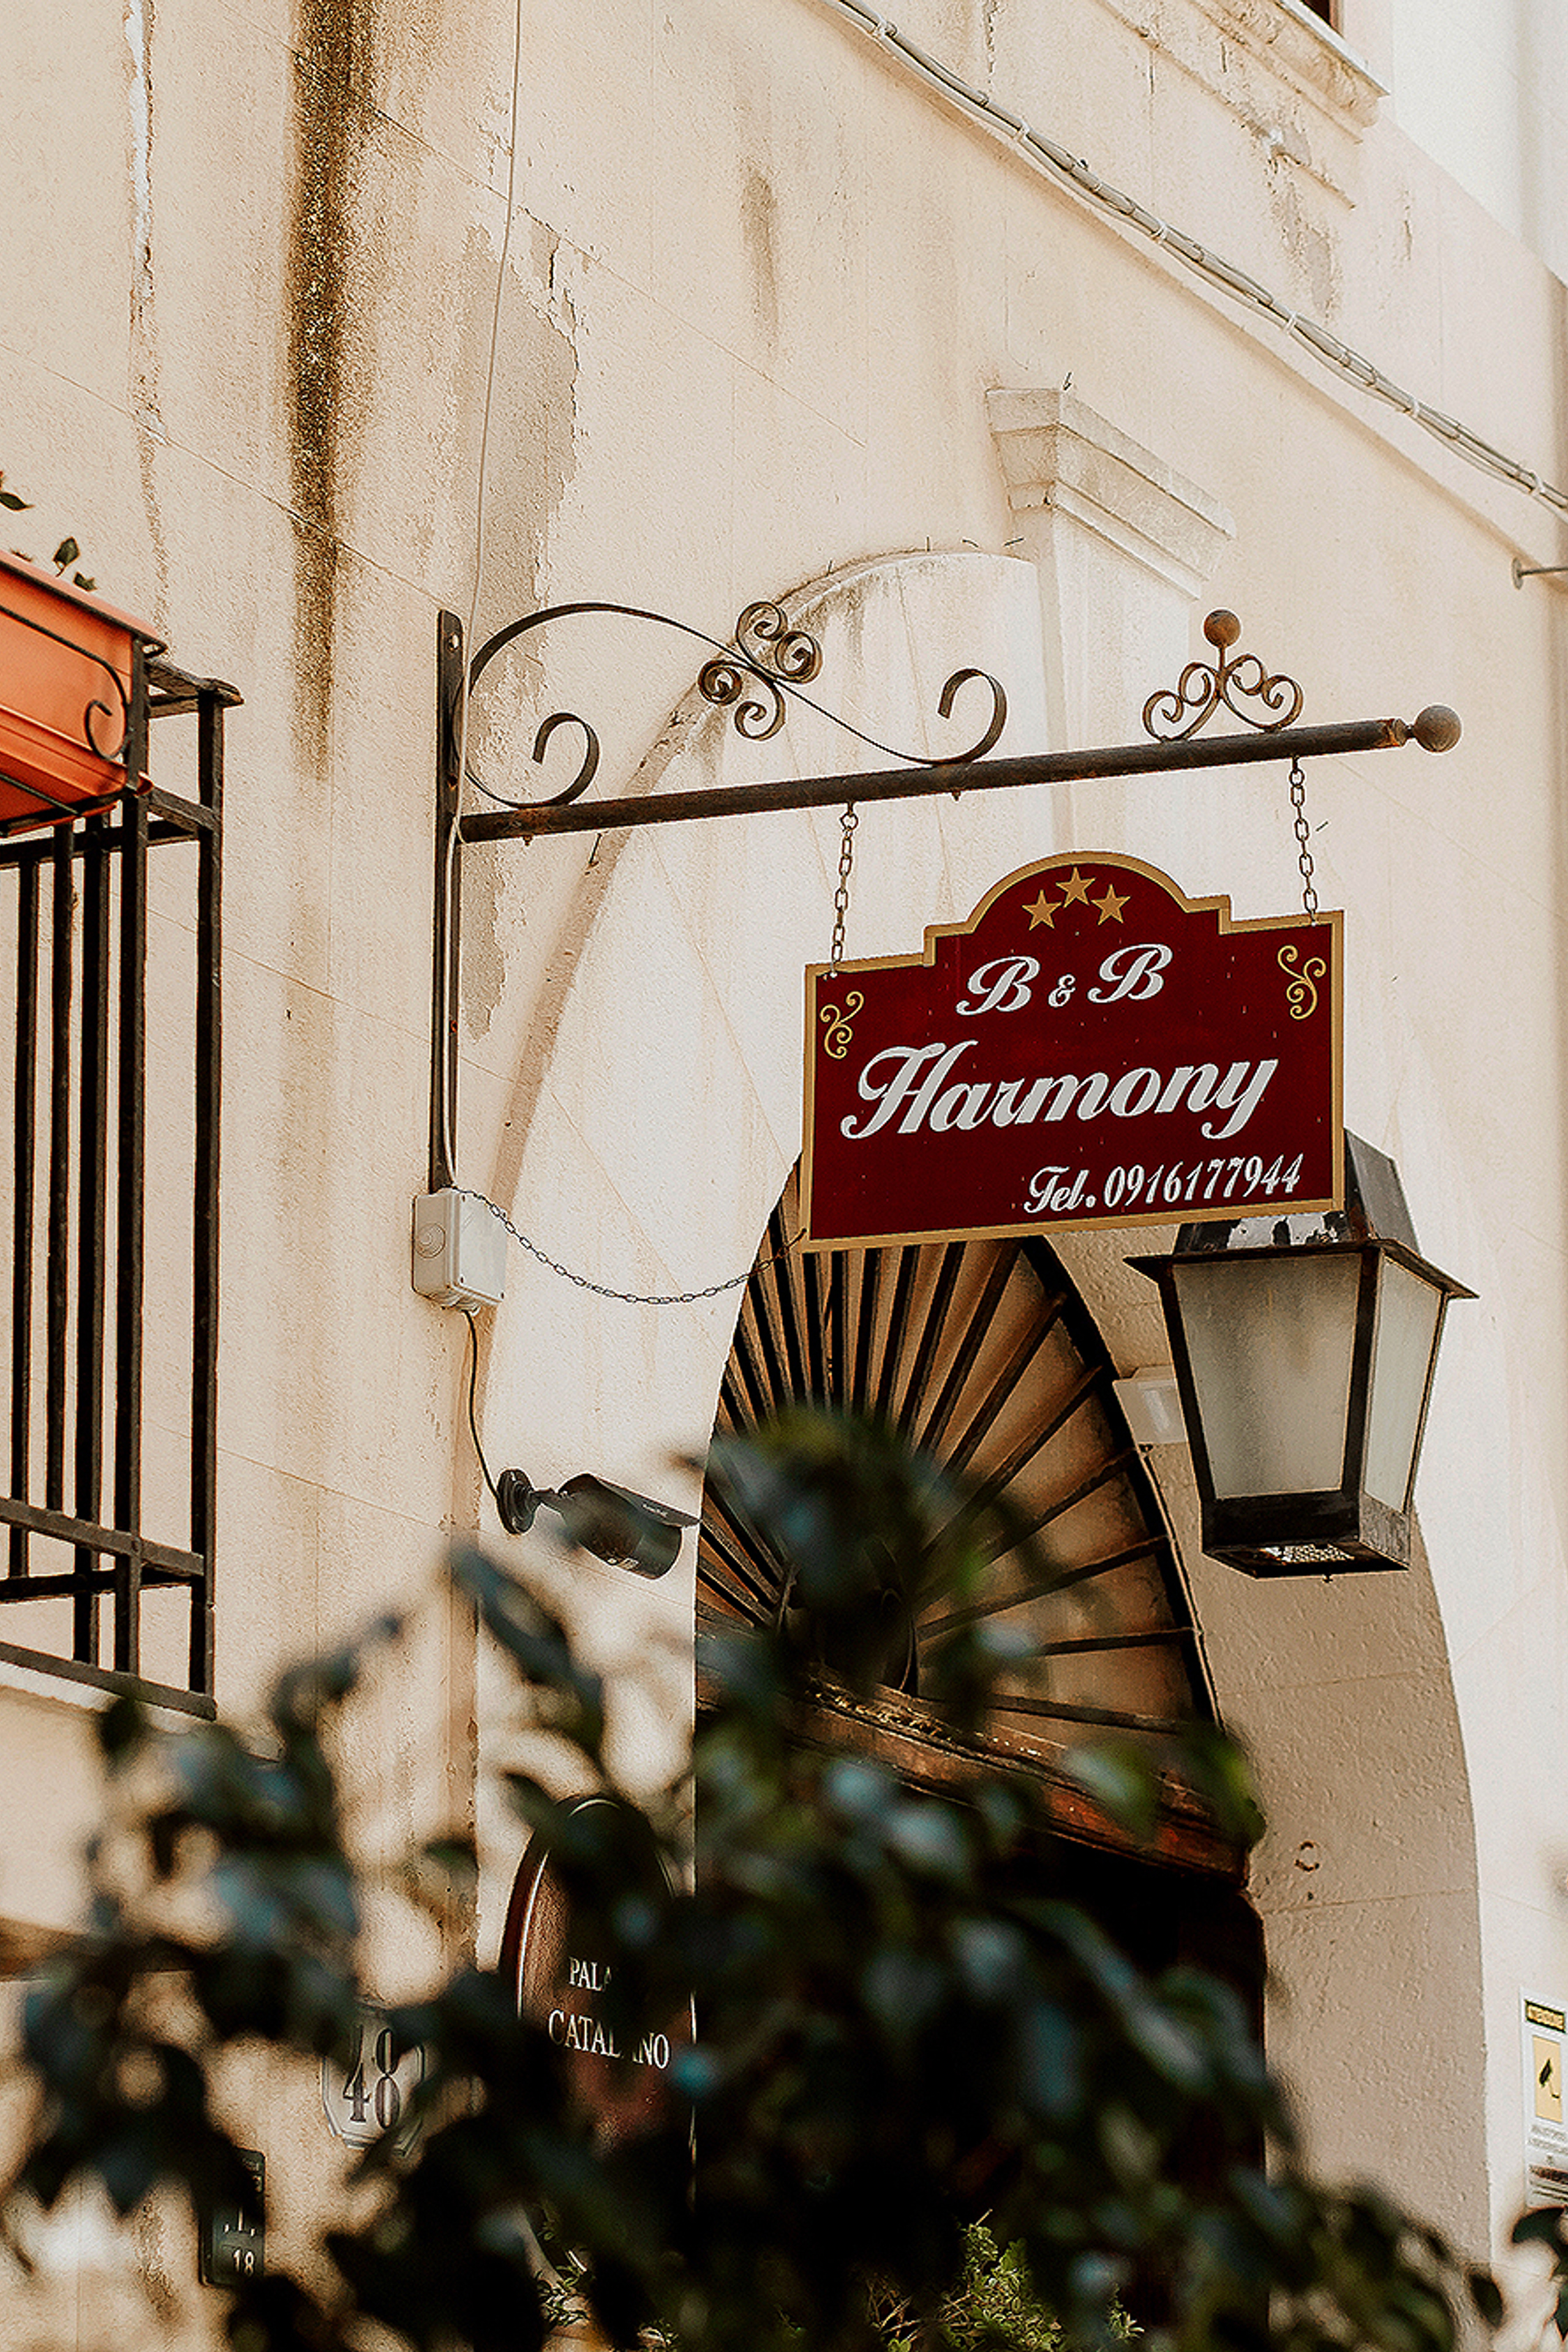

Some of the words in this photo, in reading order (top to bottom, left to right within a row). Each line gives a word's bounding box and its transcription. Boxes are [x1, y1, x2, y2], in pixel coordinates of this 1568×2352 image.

[956, 956, 1040, 1016] B
[1048, 974, 1076, 1008] &
[1087, 943, 1173, 1003] B
[840, 1039, 1279, 1140] Harmony
[1023, 1166, 1096, 1213] Tel.
[1104, 1153, 1304, 1208] 0916177944
[548, 2009, 670, 2069] CATALNO
[343, 2024, 401, 2130] 48
